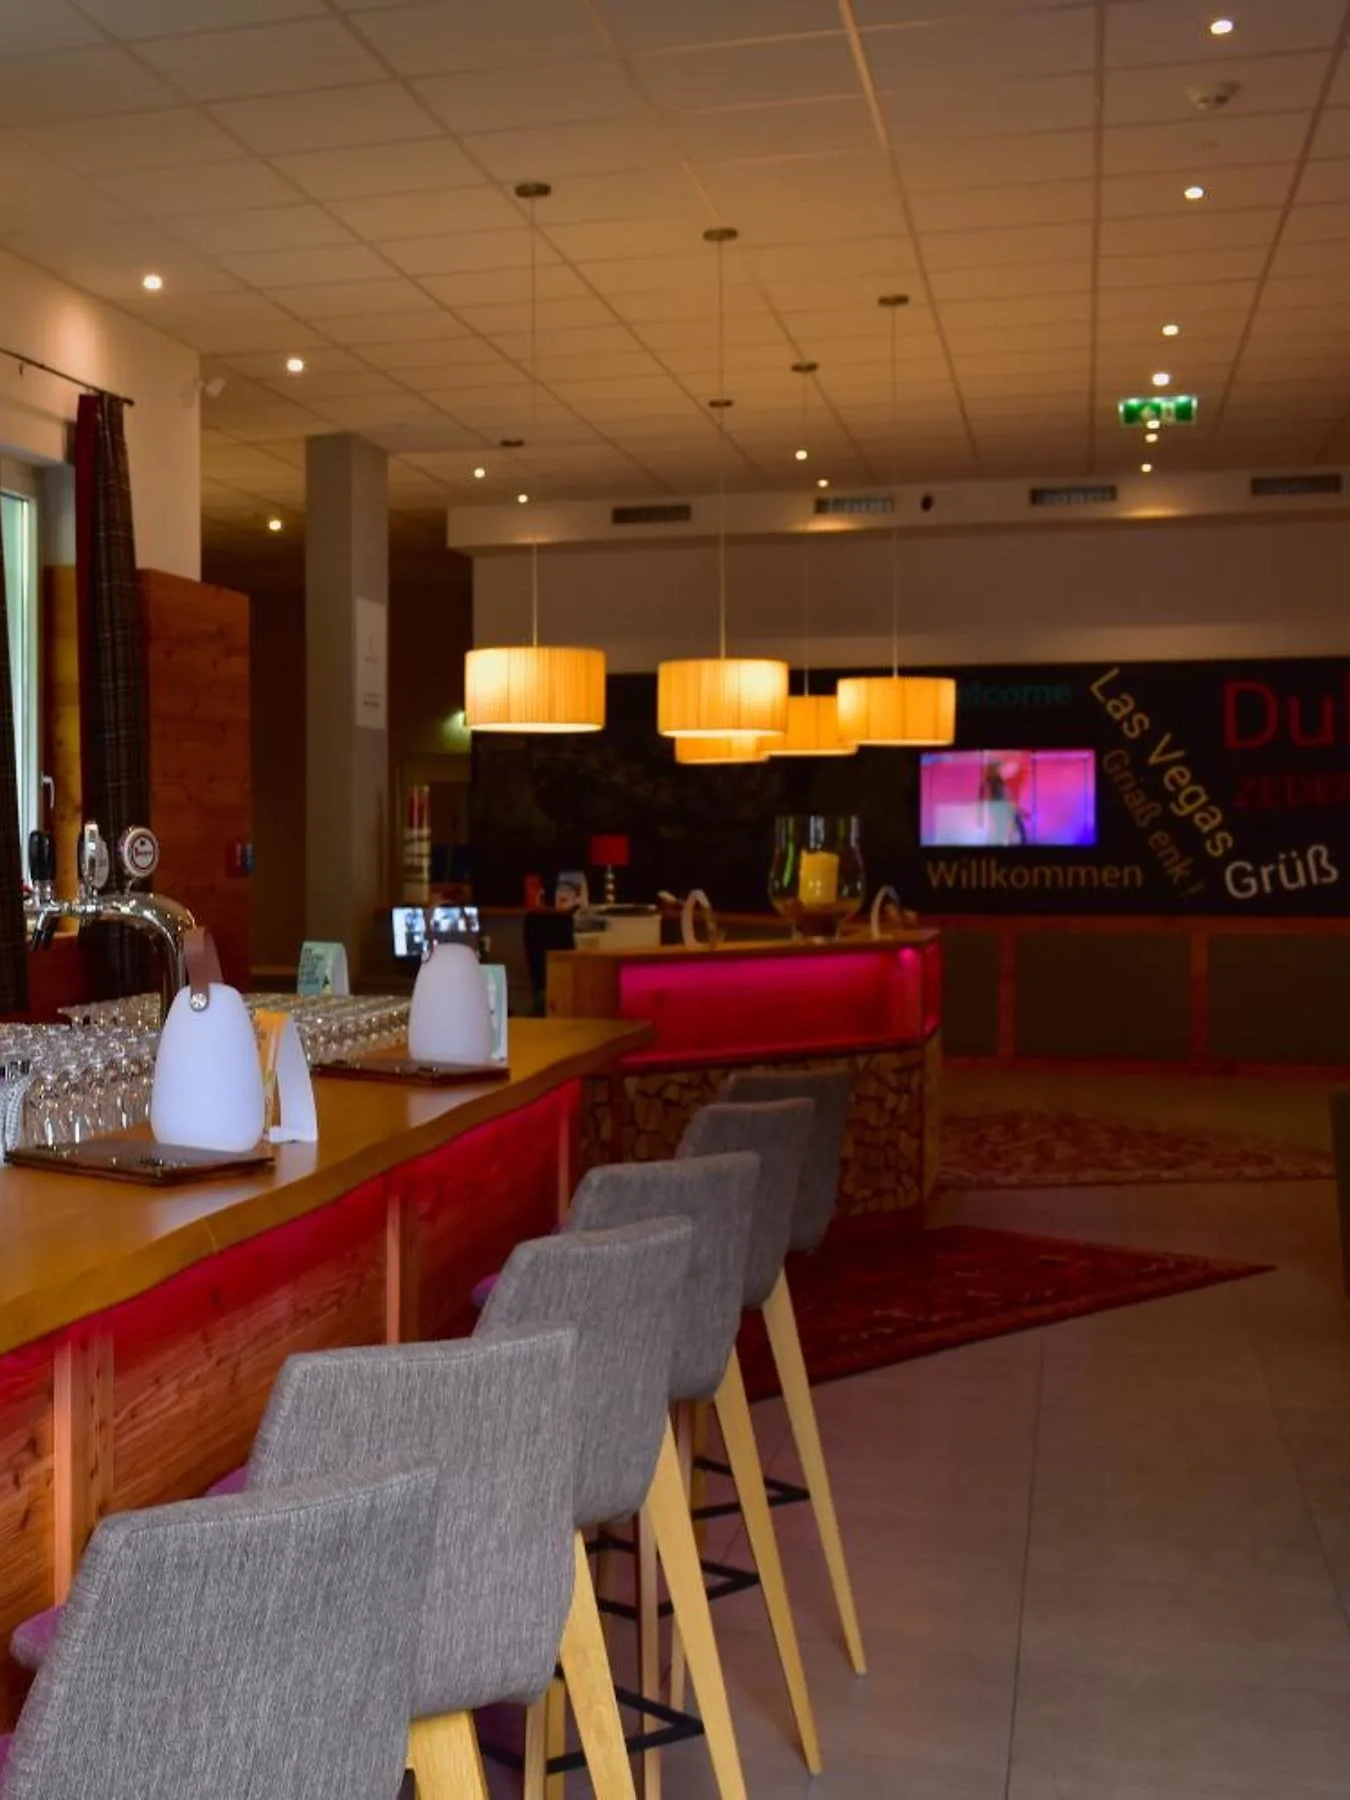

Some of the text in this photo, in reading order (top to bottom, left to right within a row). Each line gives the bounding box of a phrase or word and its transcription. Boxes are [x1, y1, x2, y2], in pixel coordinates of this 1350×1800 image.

[1090, 666, 1235, 858] Las Vegas
[926, 856, 1144, 890] Willkommen
[1224, 843, 1340, 900] Grüß
